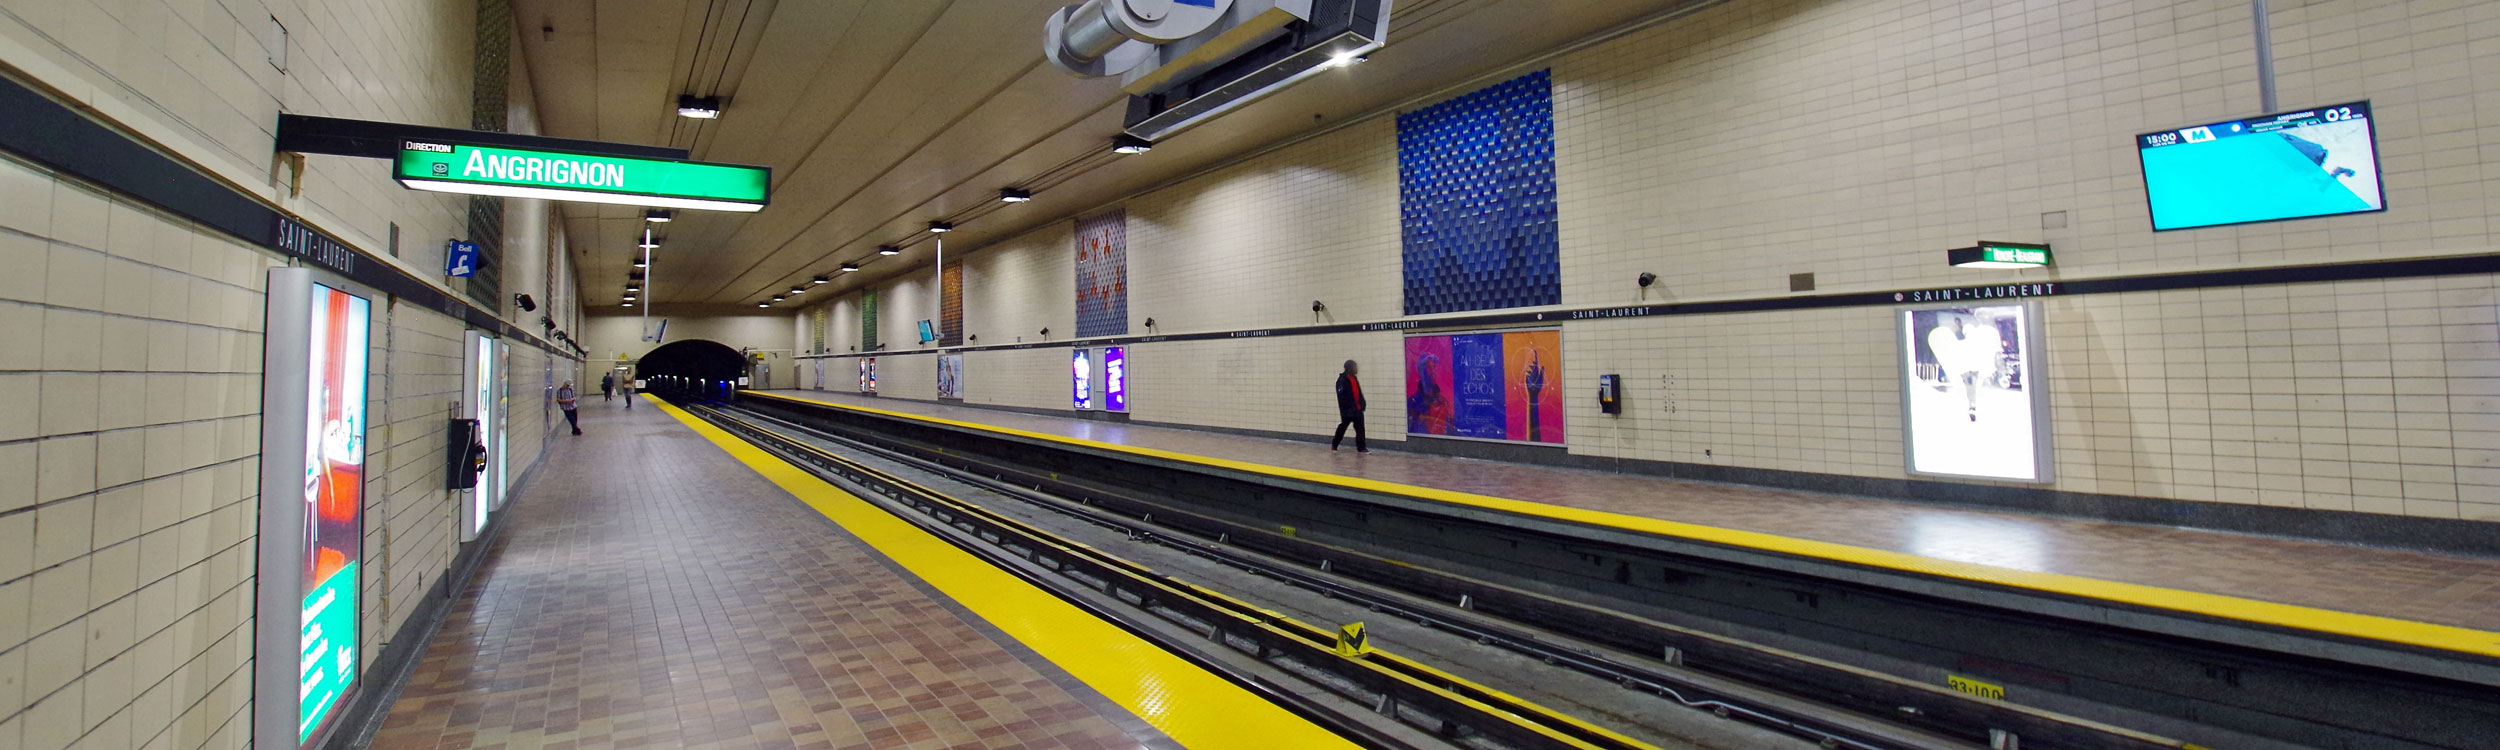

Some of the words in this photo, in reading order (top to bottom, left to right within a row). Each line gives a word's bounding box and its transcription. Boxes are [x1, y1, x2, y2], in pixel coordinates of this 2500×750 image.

[2324, 106, 2352, 122] 02
[405, 141, 451, 153] DIRECTION
[463, 149, 624, 187] ANGRIGNON
[279, 218, 355, 275] SAINT-LAURENT
[458, 244, 472, 253] Bell
[1914, 283, 2054, 302] SAINT-LAURENT
[1572, 306, 1650, 319] SAINT-LAURENT
[1370, 320, 1418, 331] SAINT-LAURENT
[1470, 368, 1486, 380] DES
